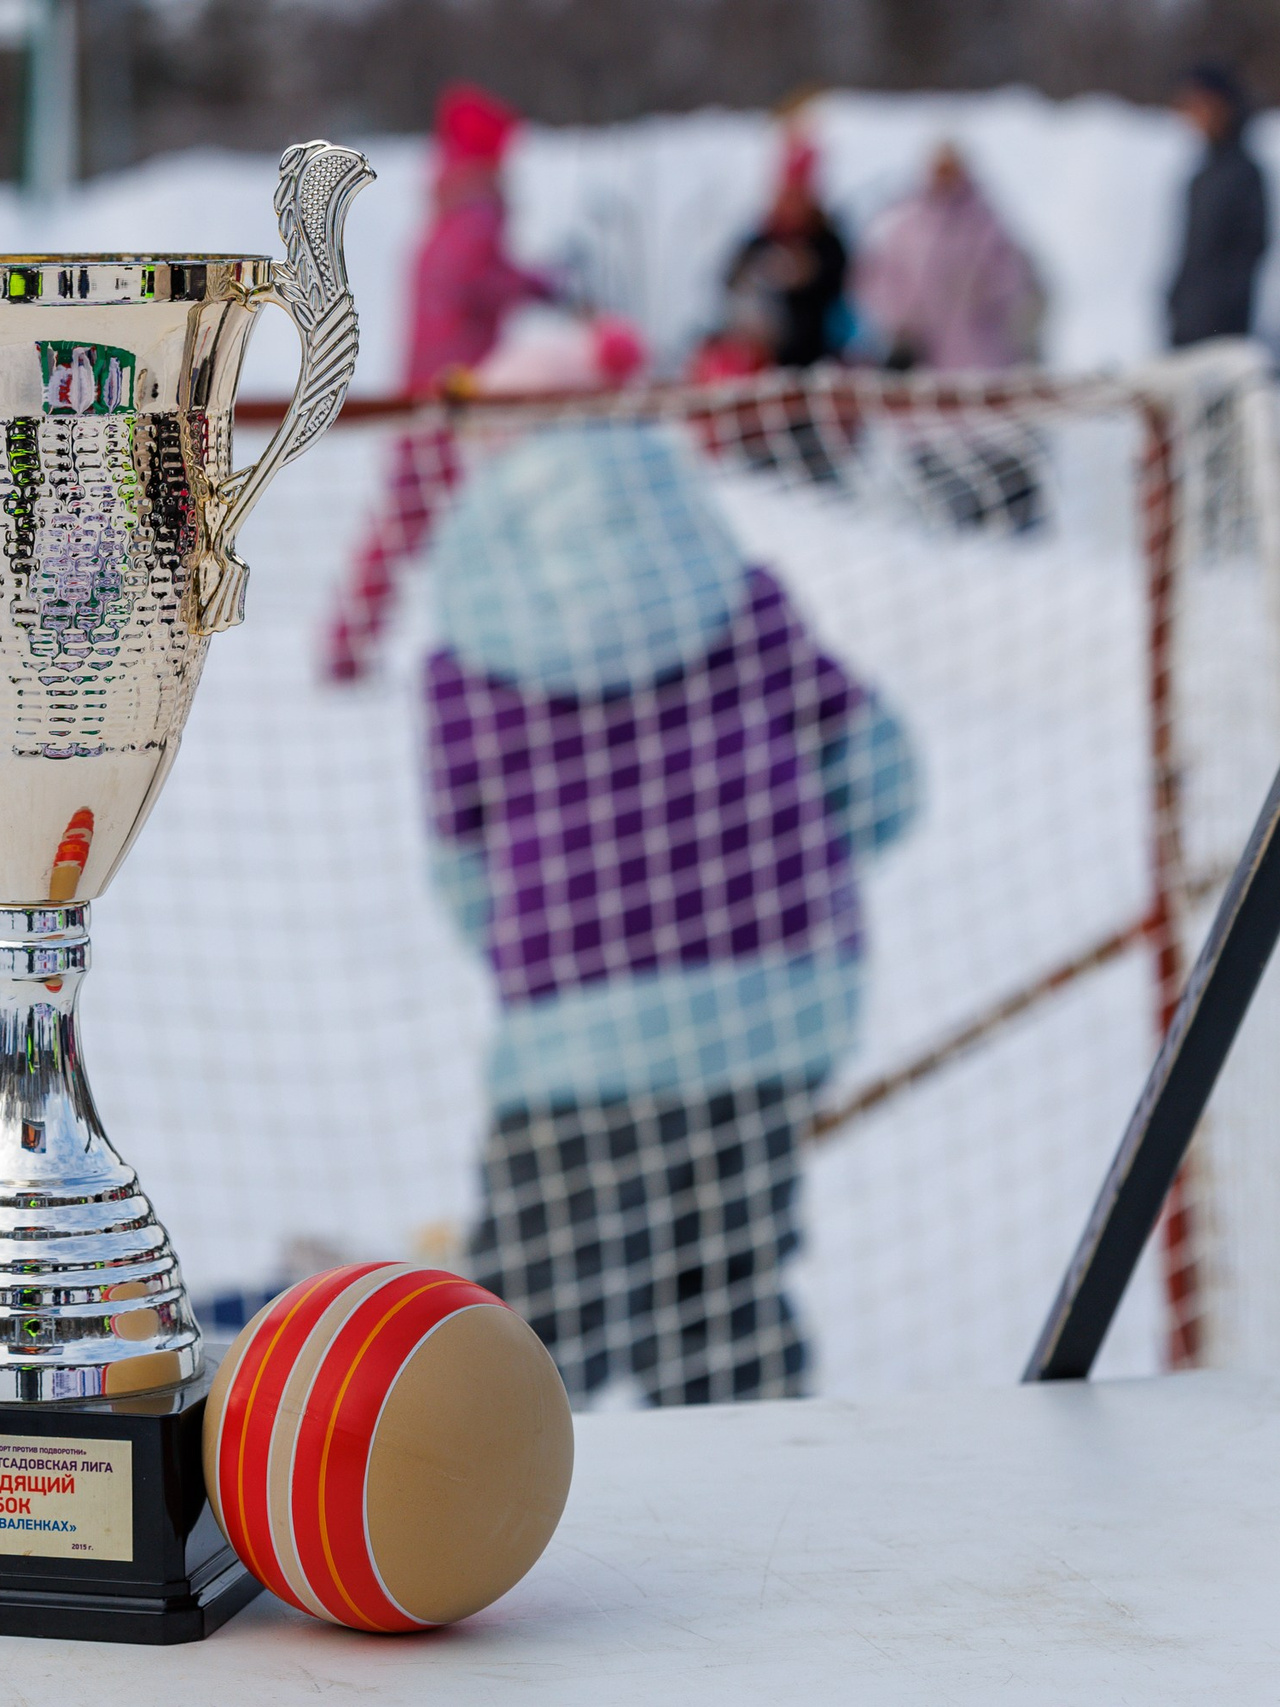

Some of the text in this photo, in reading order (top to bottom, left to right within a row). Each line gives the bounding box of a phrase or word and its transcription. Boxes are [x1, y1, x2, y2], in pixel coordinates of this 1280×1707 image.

[39, 1447, 87, 1455] ПОДВОРОТНИ»
[81, 1461, 113, 1473] ЛИГА
[0, 1518, 77, 1532] ВАЛЕНКАХ»
